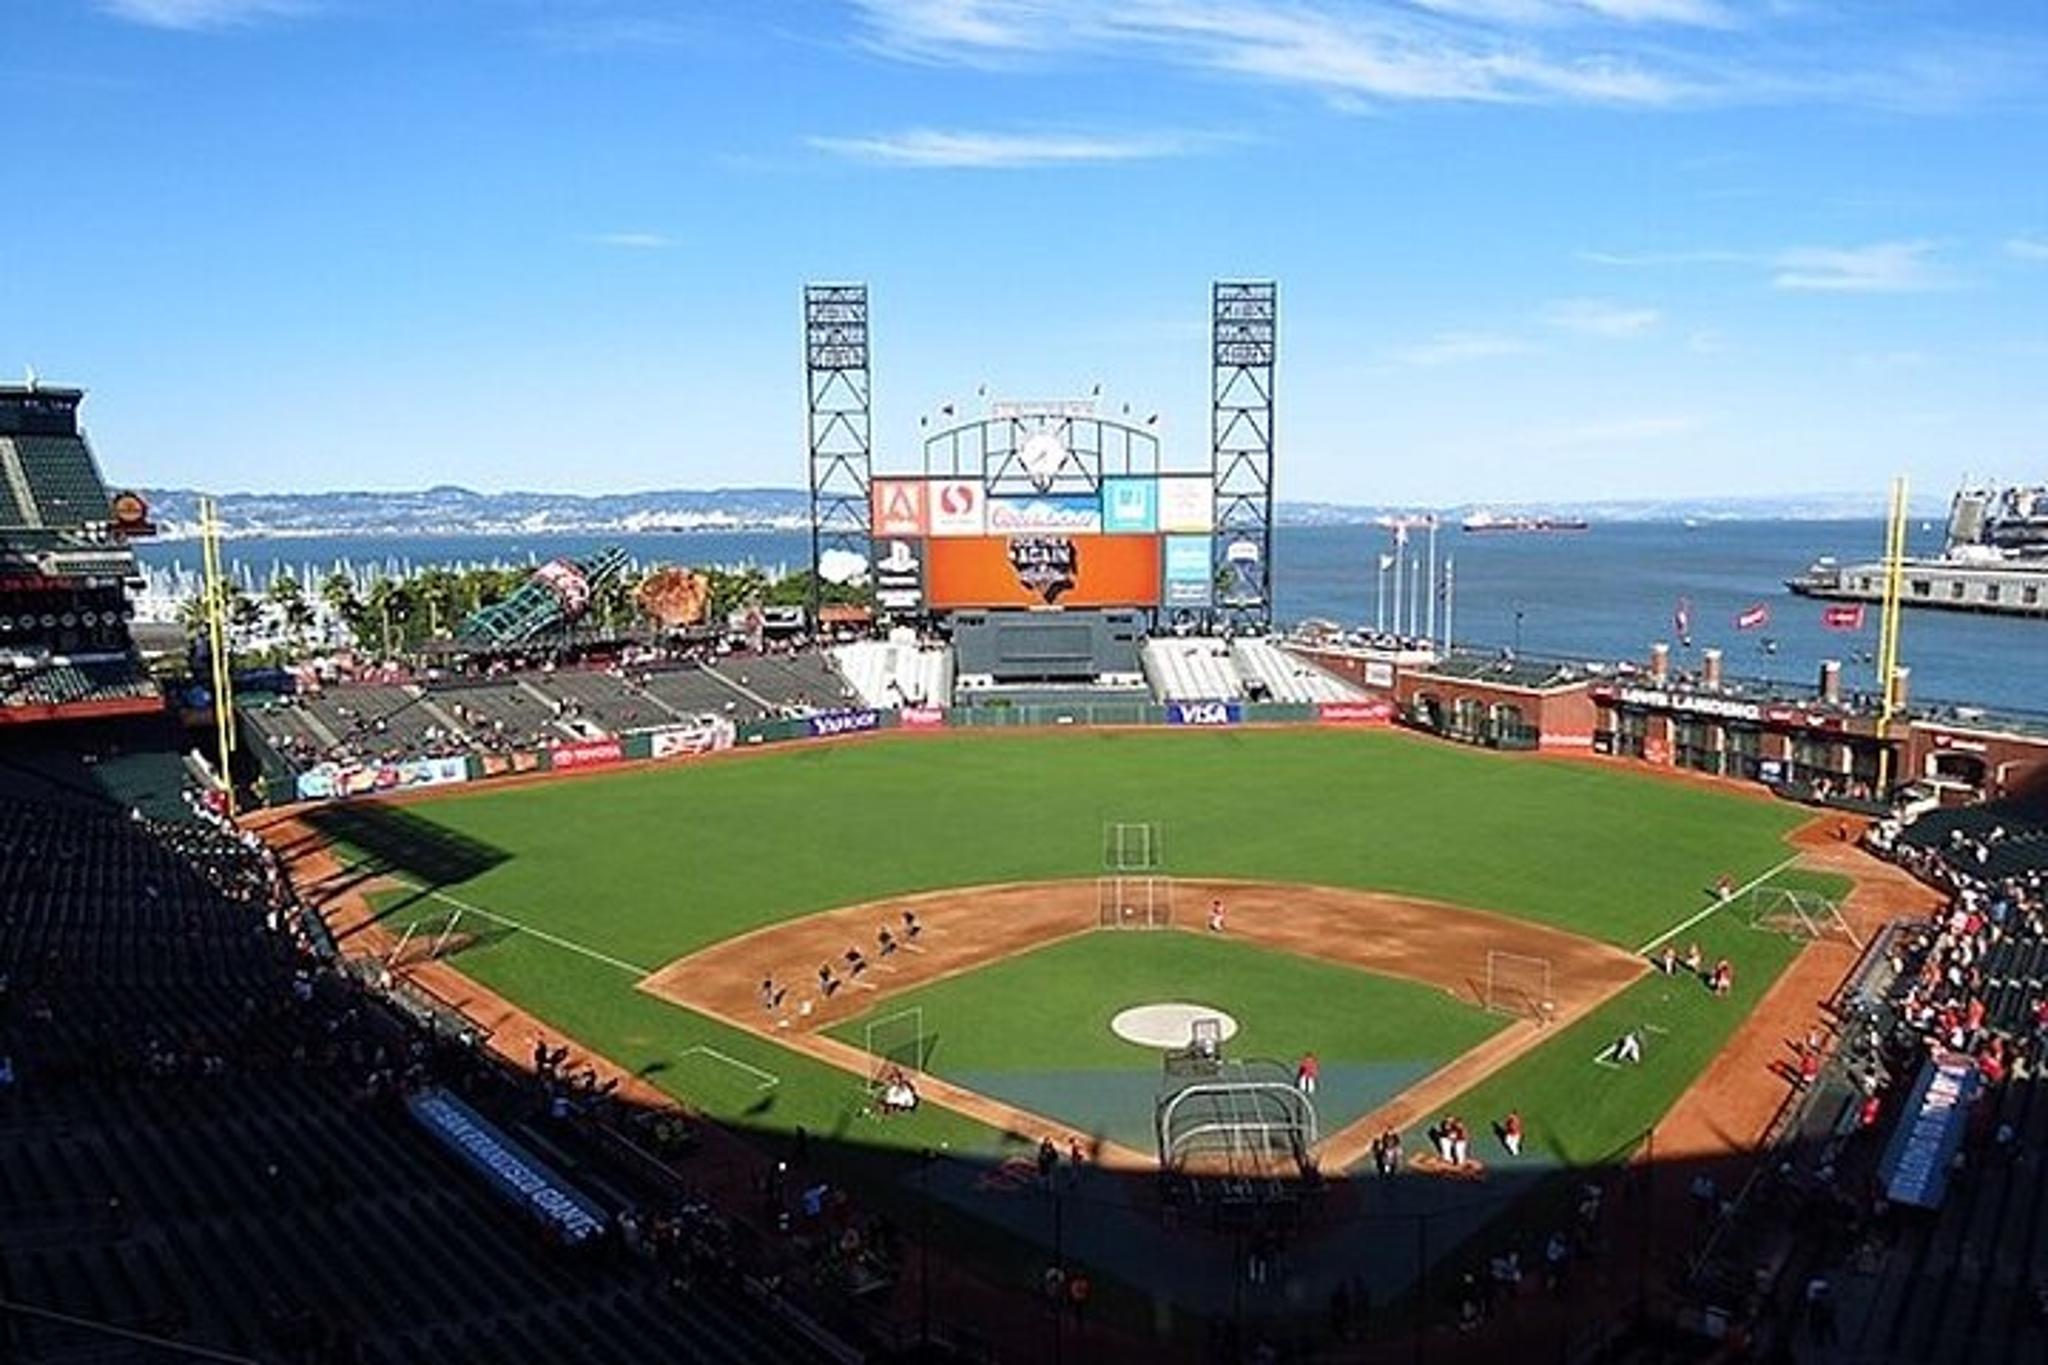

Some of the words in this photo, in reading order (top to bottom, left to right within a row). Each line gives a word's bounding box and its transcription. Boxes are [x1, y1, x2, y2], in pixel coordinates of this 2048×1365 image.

[1017, 547, 1070, 564] AGAIN
[1180, 703, 1227, 723] VISA
[1671, 694, 1760, 720] LANDING
